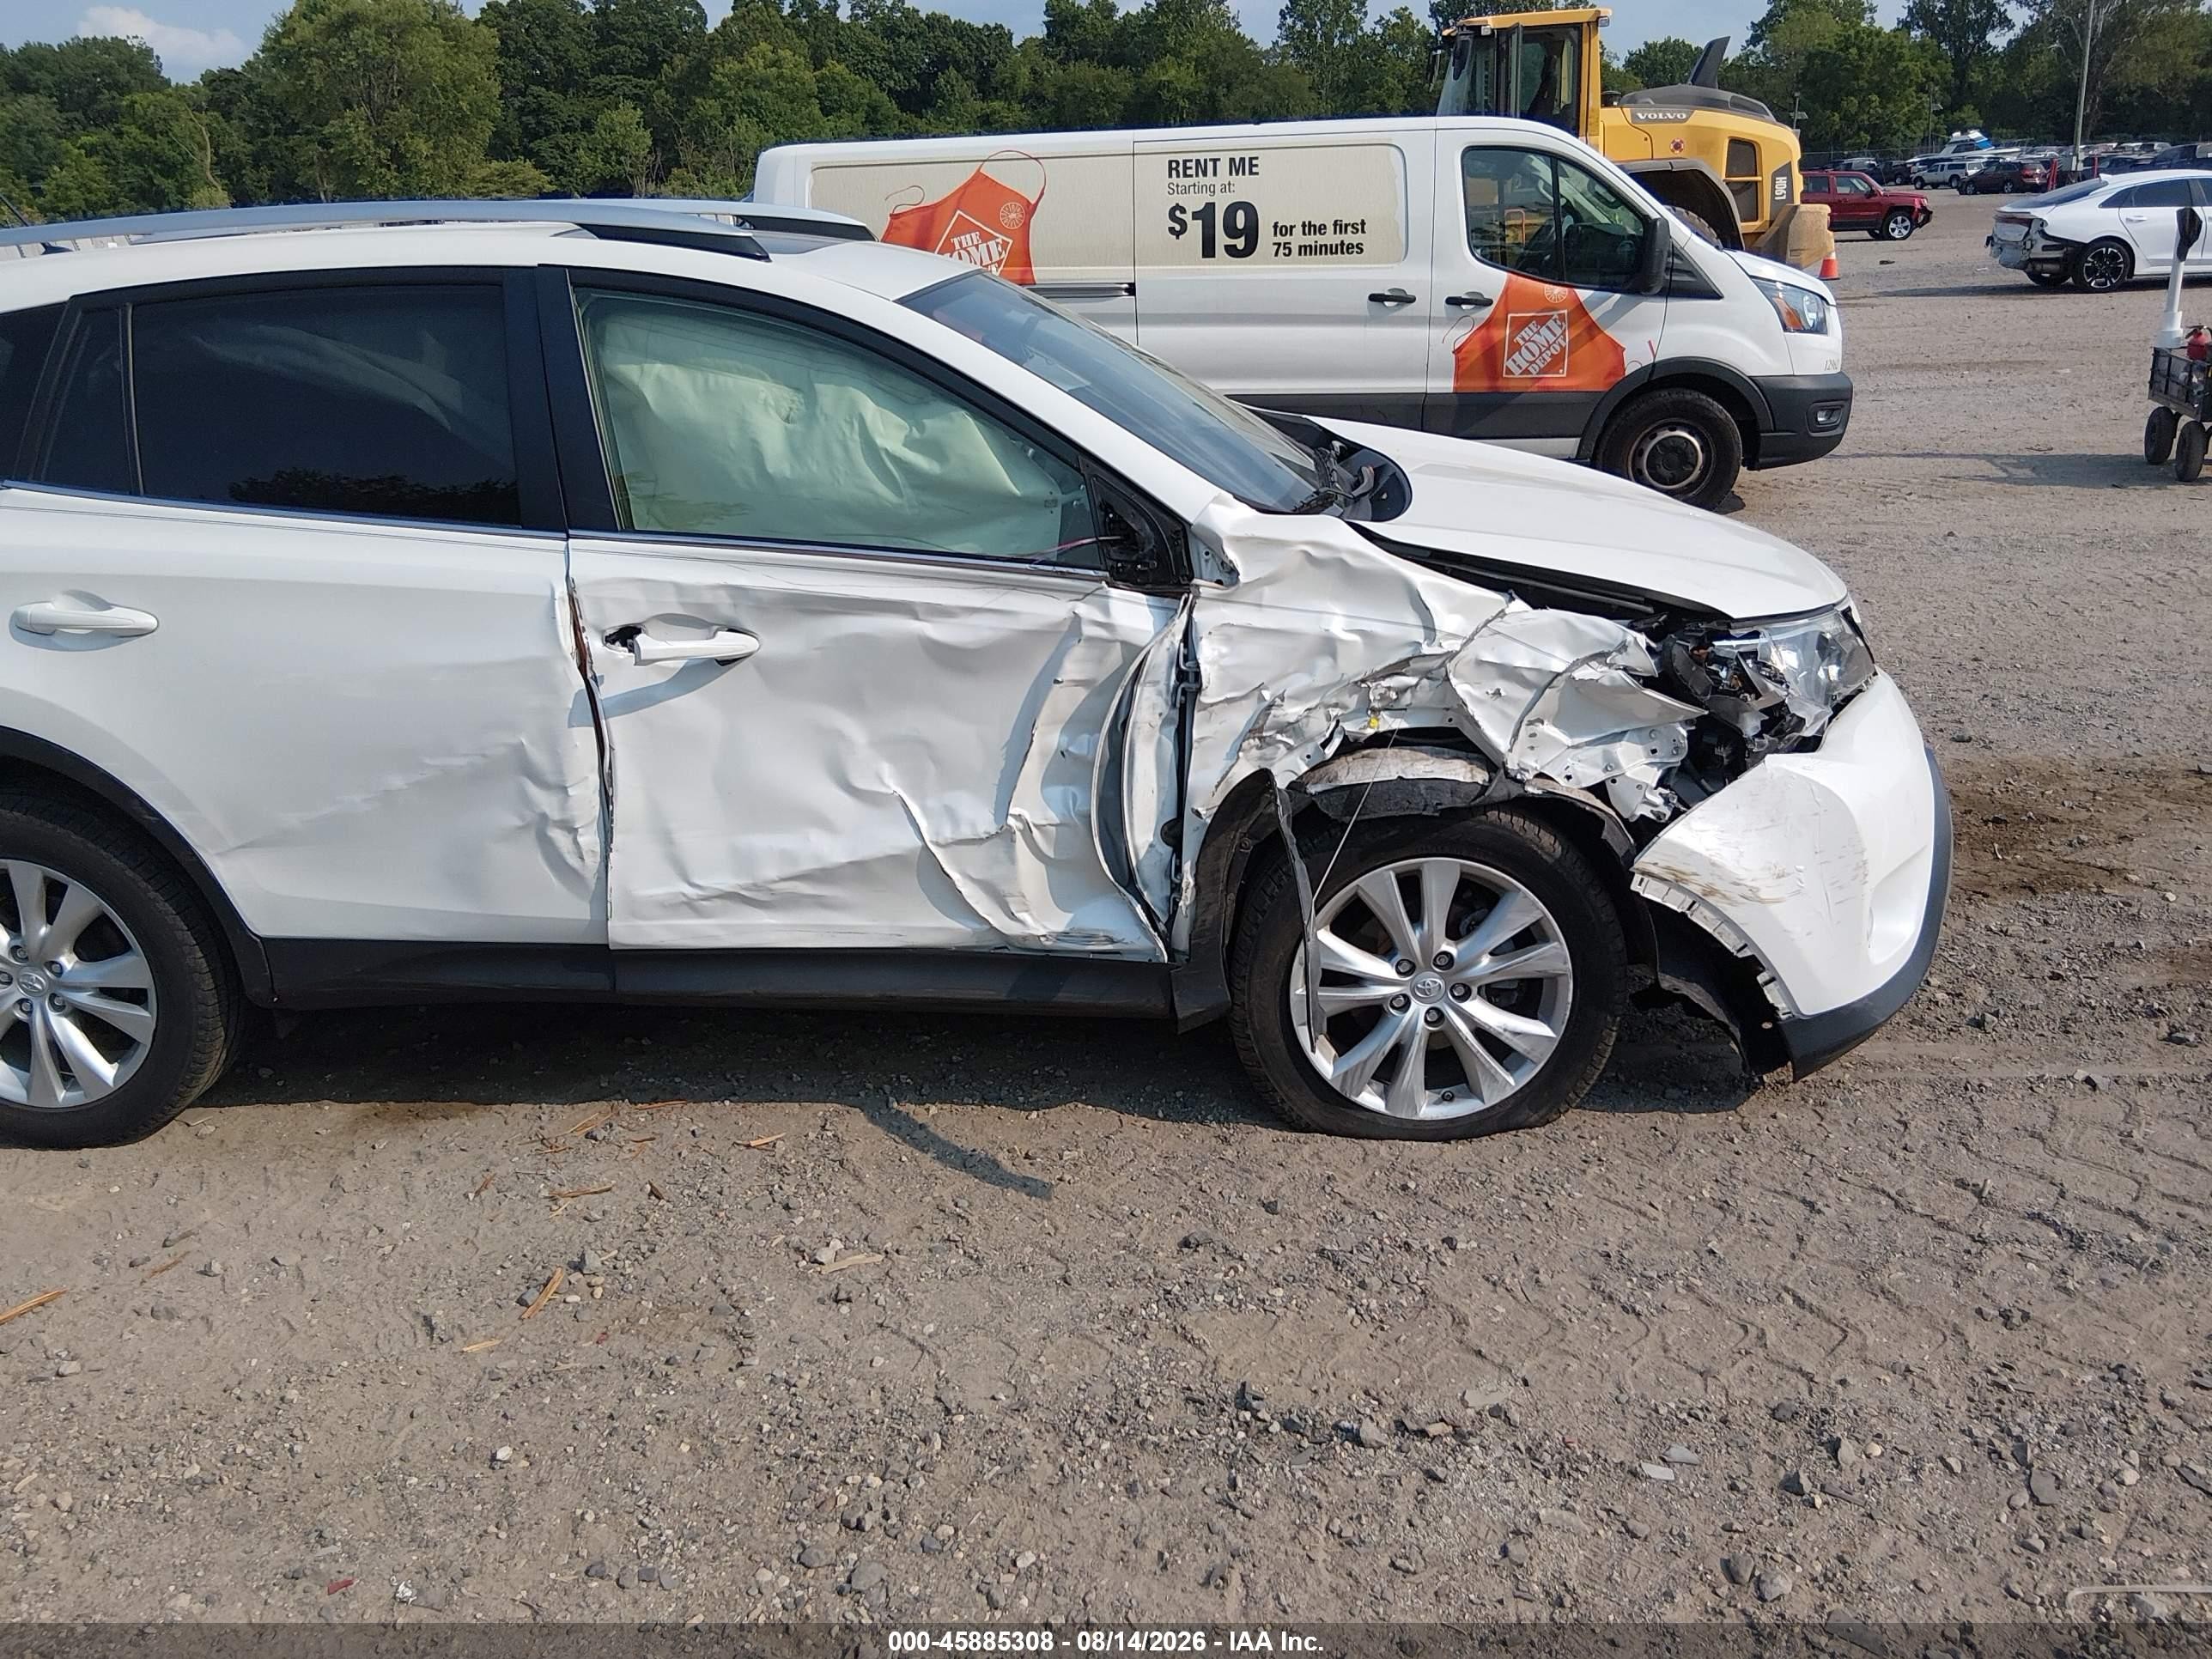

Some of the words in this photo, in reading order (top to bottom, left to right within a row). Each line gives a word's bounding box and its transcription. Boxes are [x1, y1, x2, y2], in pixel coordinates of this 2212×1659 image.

[1168, 158, 1221, 179] RENT
[1229, 156, 1260, 176] ME
[1167, 182, 1216, 197] Starting
[1219, 180, 1236, 194] at:
[1774, 177, 1787, 200] L90H
[1168, 201, 1260, 259] $19
[1272, 221, 1297, 238] for
[1300, 220, 1328, 237] the
[1332, 218, 1367, 235] first
[951, 231, 981, 251] THE
[1272, 242, 1292, 258] 75
[1297, 240, 1364, 257] minutes
[1505, 314, 1567, 375] HOME
[1513, 320, 1541, 346] THE
[1527, 334, 1567, 375] DEPOT
